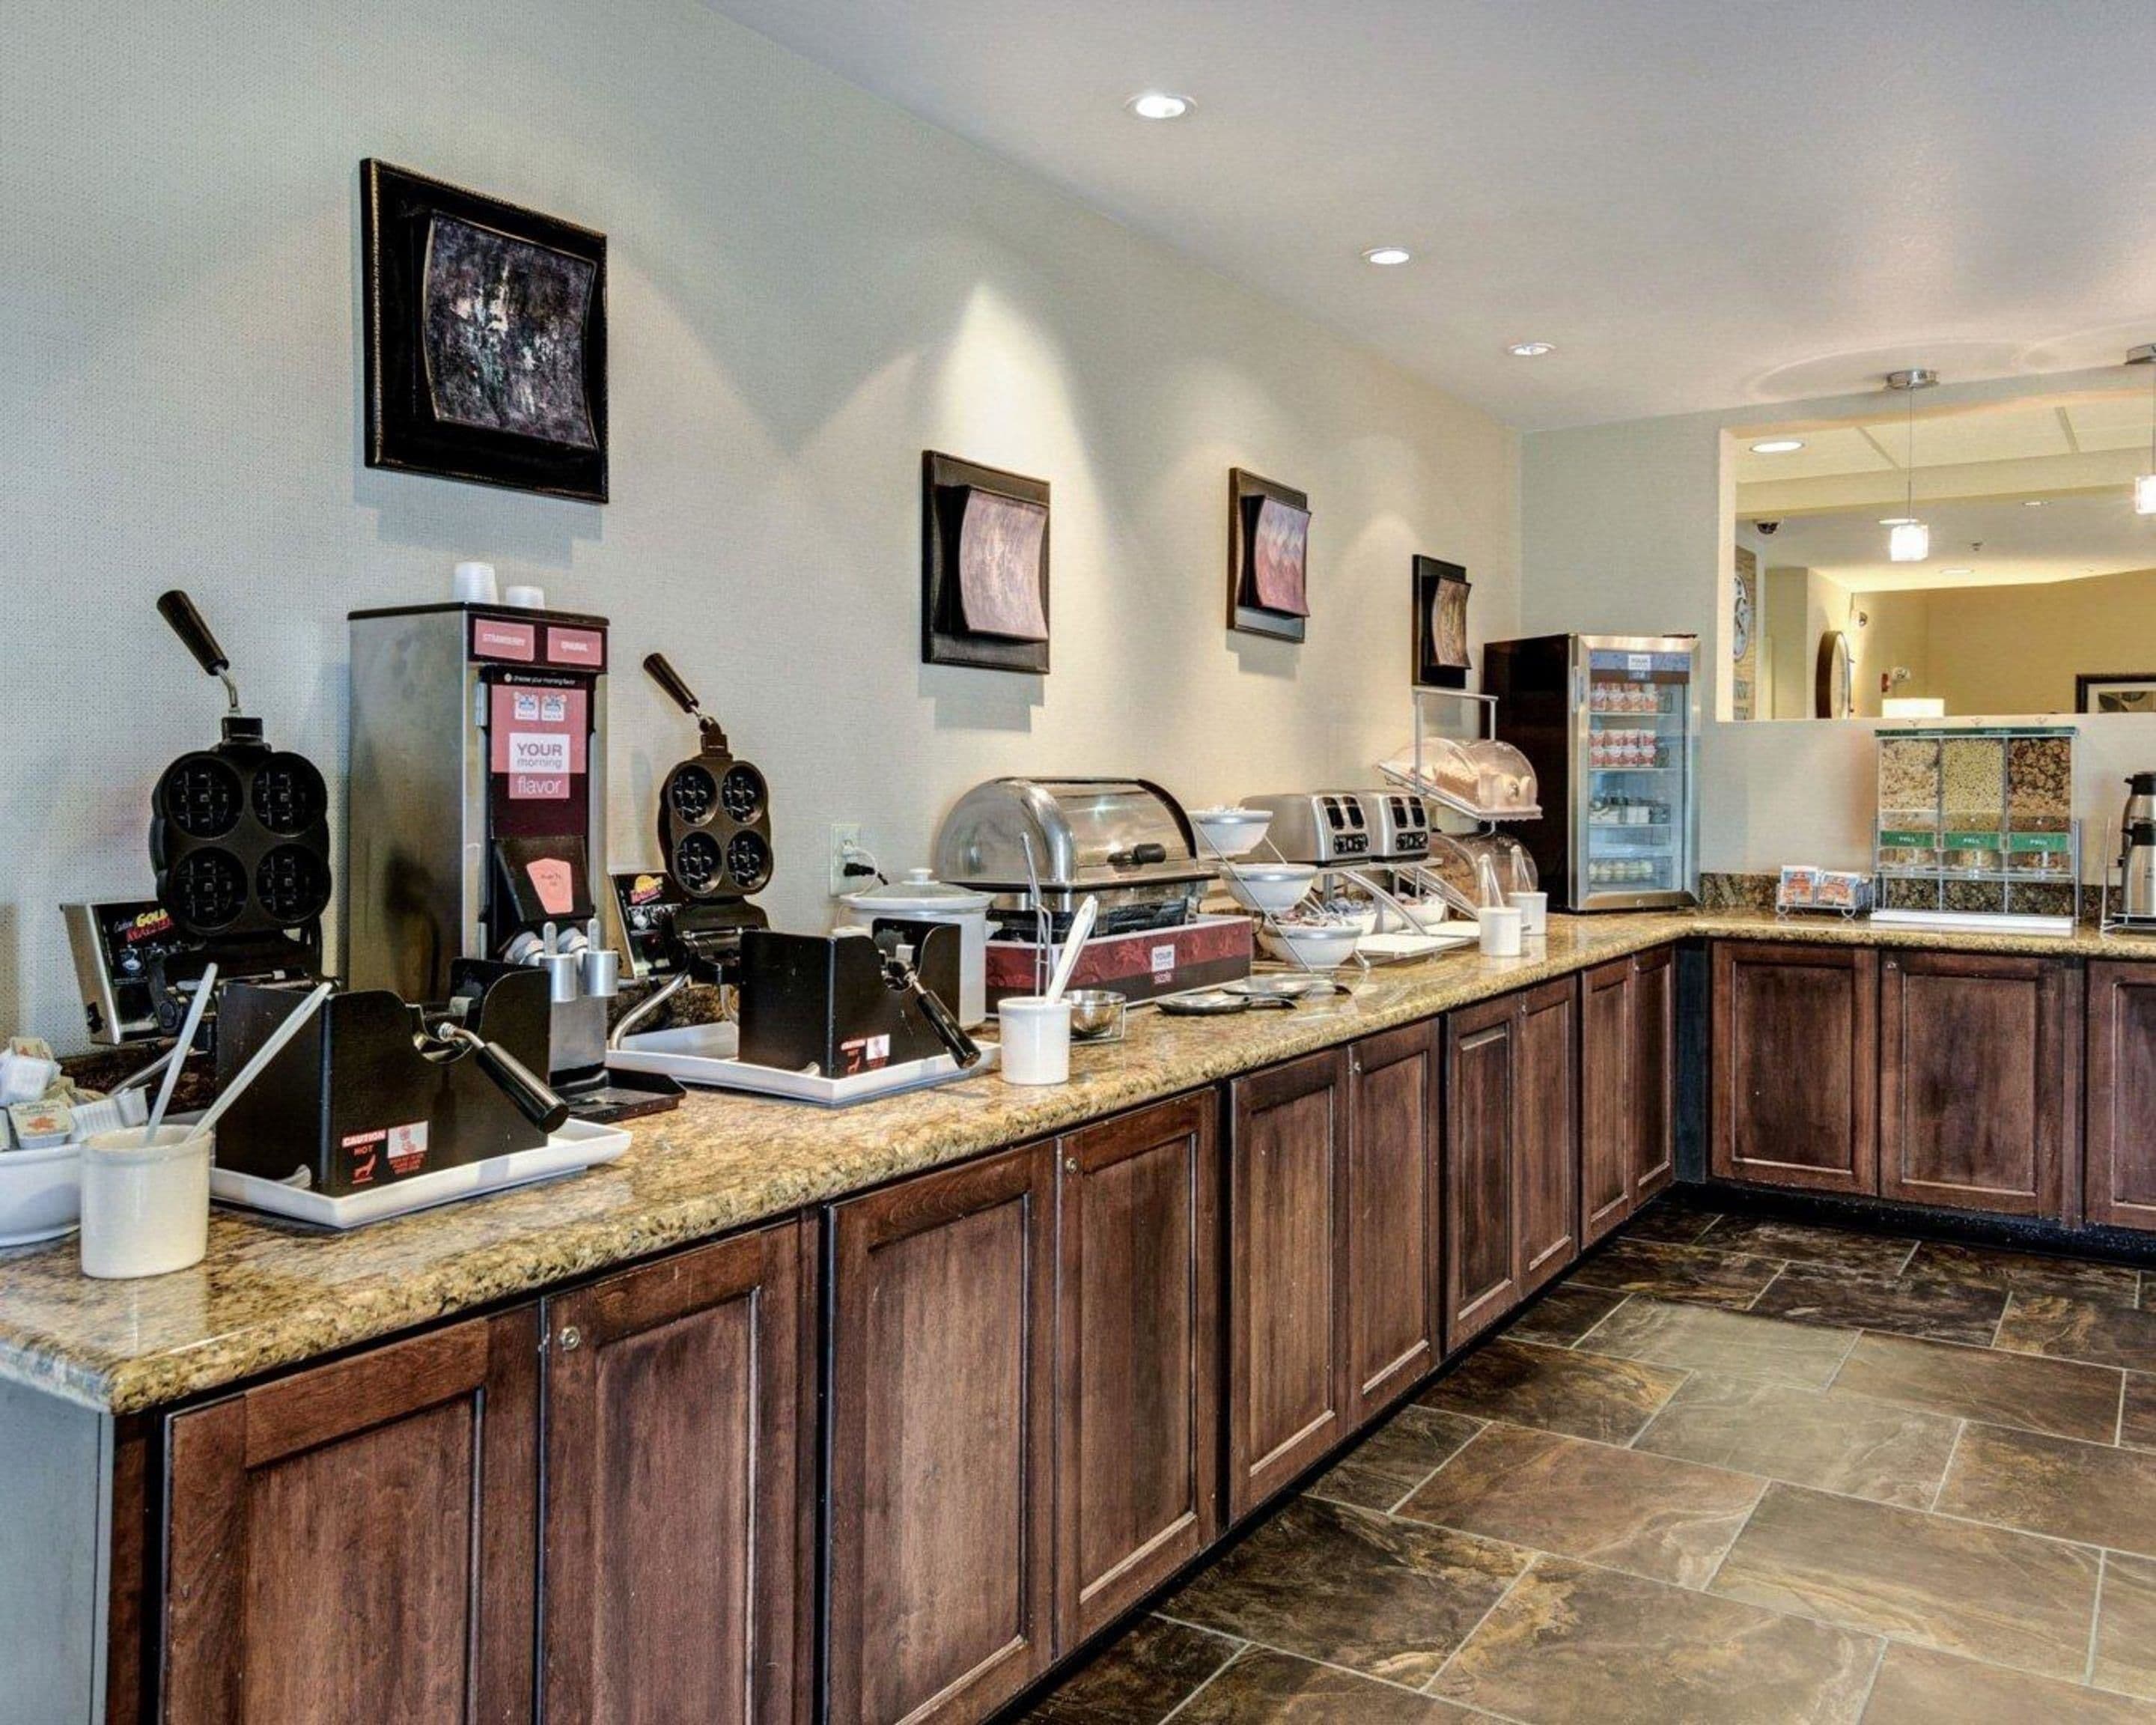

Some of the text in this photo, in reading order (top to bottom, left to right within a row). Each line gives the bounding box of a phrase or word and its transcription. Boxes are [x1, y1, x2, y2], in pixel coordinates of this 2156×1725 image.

[517, 743, 562, 756] YOUR
[517, 757, 562, 768] morning
[517, 776, 561, 794] flavor
[135, 908, 168, 928] GOLD
[344, 1130, 385, 1146] CAUTION
